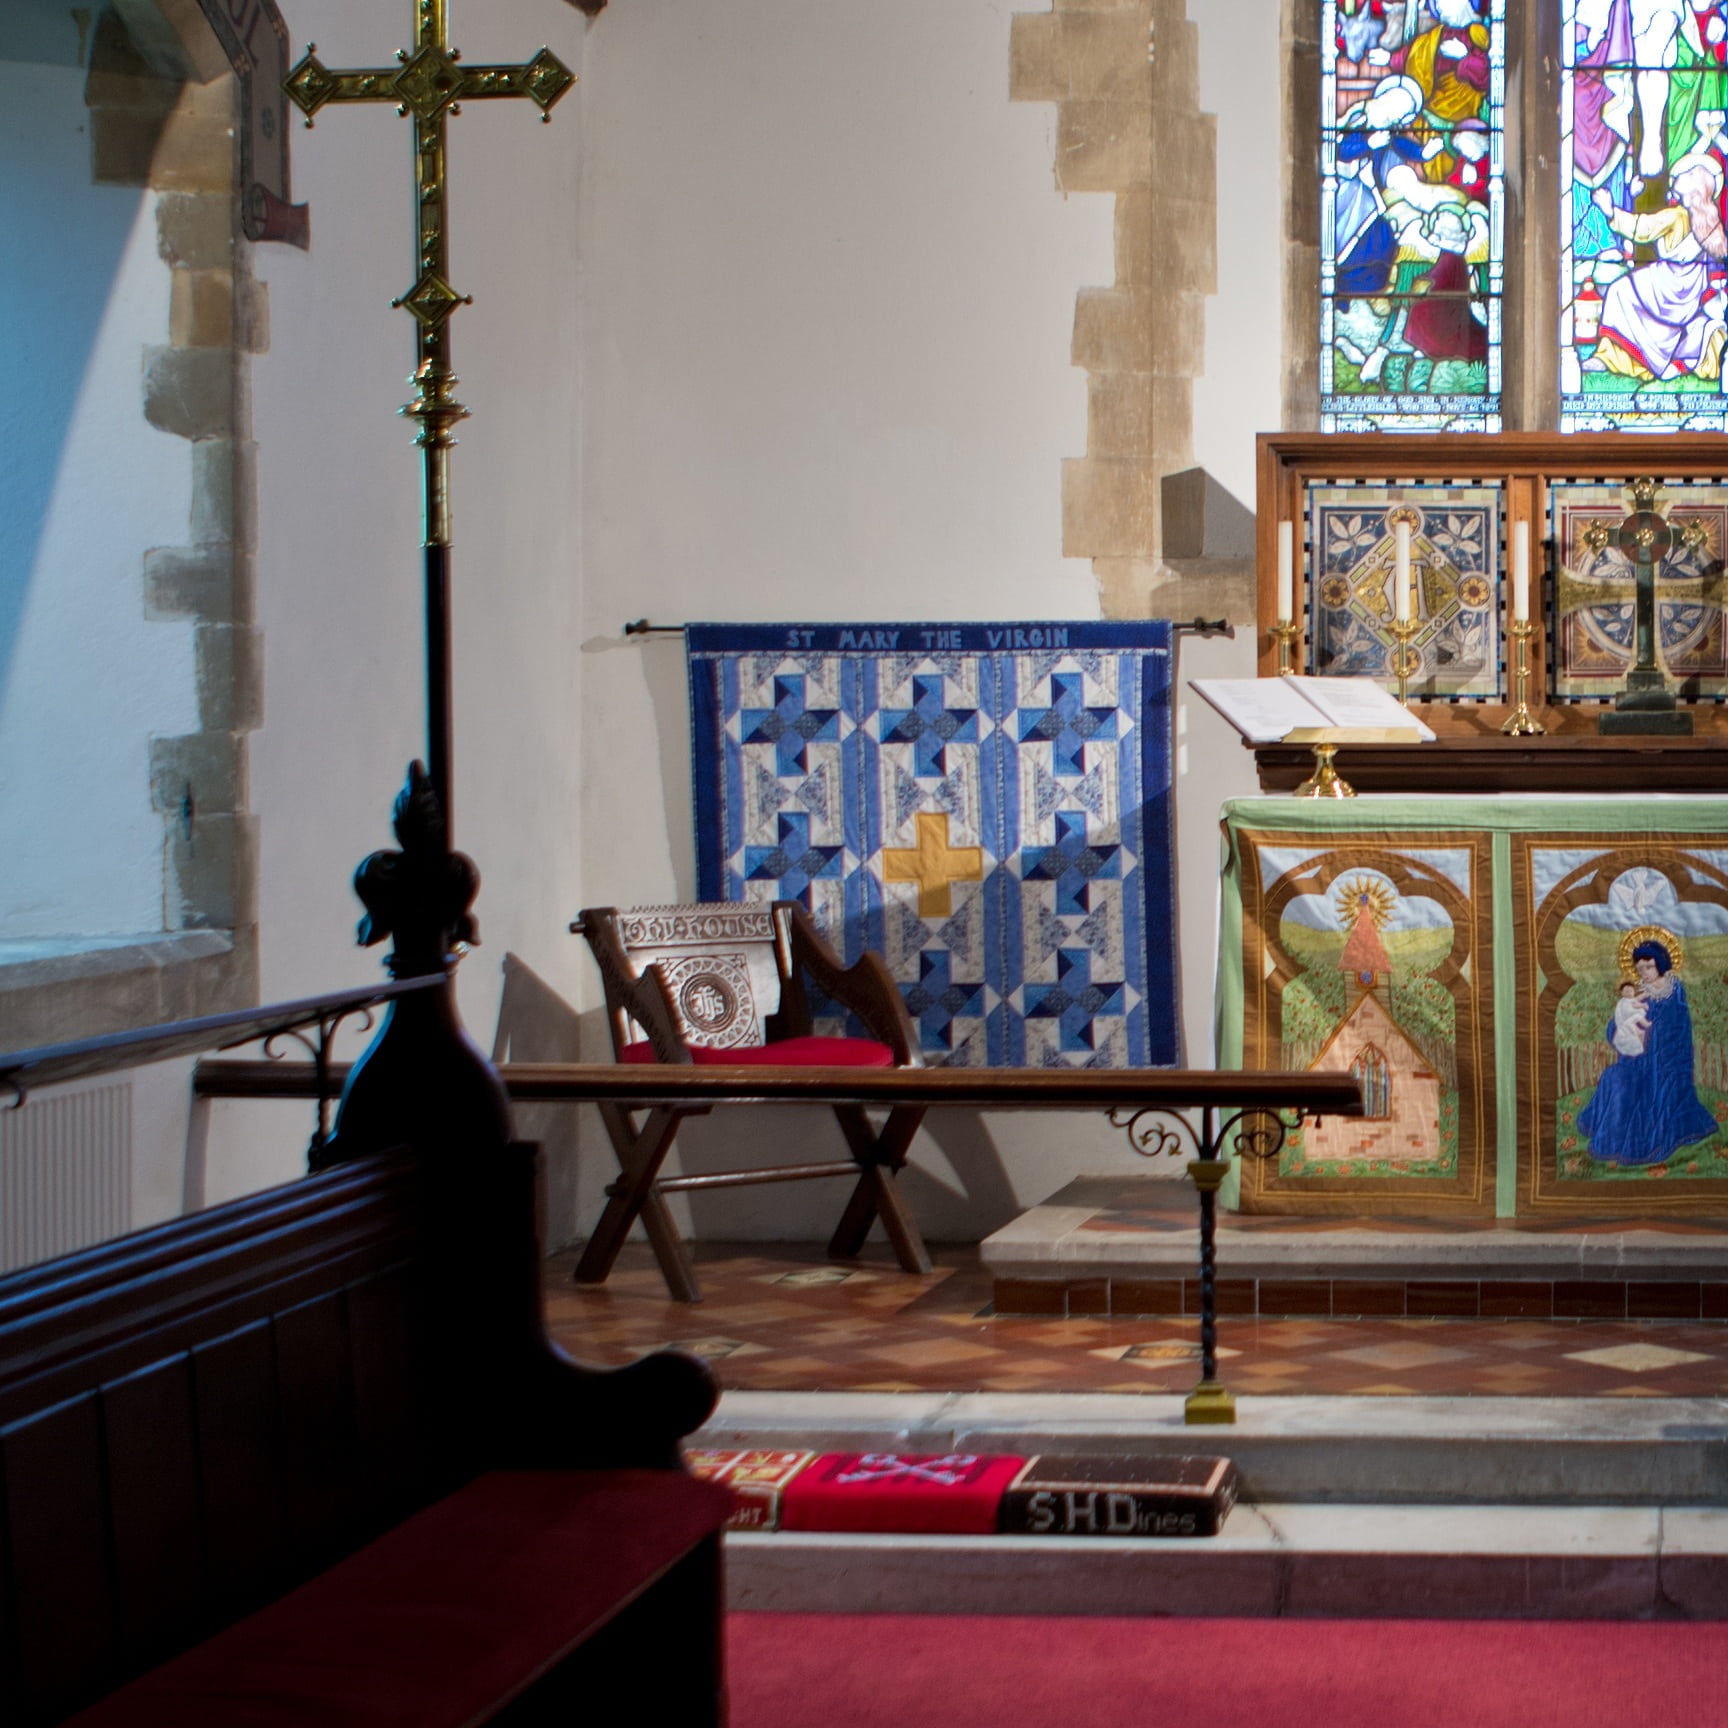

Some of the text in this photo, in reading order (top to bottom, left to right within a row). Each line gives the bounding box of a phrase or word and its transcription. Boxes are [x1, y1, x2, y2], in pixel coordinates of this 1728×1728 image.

[786, 628, 1070, 650] ST MARY THE VIRGIN
